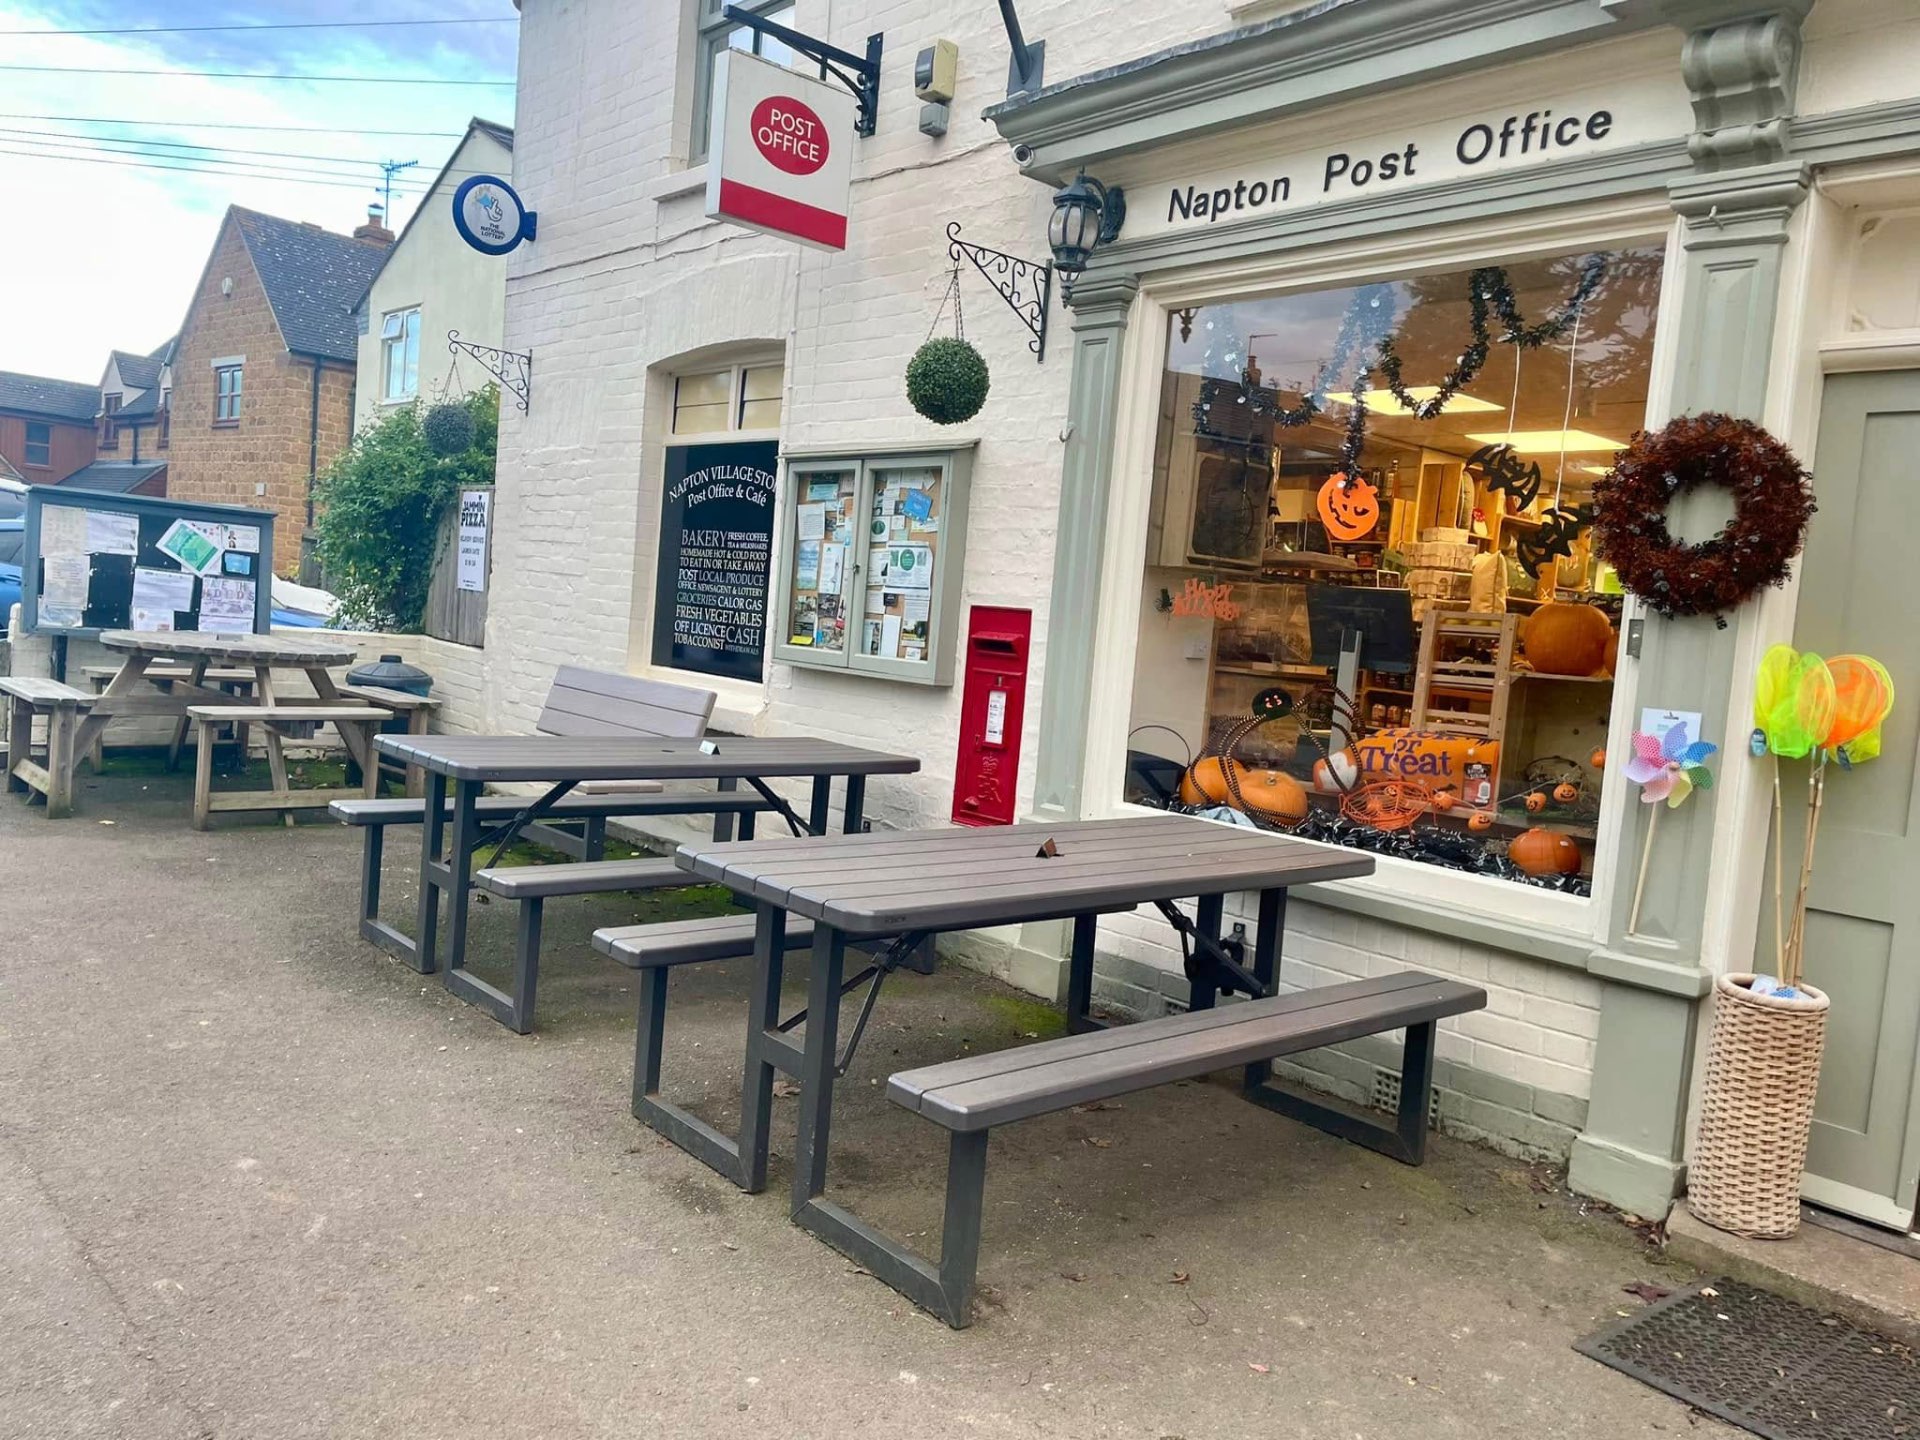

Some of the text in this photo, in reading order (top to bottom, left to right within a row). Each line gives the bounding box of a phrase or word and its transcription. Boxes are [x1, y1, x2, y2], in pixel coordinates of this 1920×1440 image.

[770, 108, 815, 139] POST
[758, 126, 820, 163] OFFICE
[1167, 110, 1613, 222] Napton Post Office
[480, 225, 506, 237] NATIONAL
[481, 230, 504, 240] LOTTERY
[669, 468, 709, 503] NAPTON
[711, 465, 754, 482] VILLAGE
[688, 483, 767, 508] Post Office & Café
[461, 513, 486, 527] PIZZA
[682, 529, 727, 547] BAKERY
[727, 531, 745, 541] FRESH
[740, 542, 767, 550] MILKSHAKES
[680, 547, 767, 561] HOMEMADE HOT & COLD FOOD
[680, 557, 766, 572] TO EAT IN OR TAKE AWAY
[678, 568, 765, 587] POST LOCAL PRODUCE
[677, 580, 764, 597] OFFICE NEWSAGENT & LOTTERY
[676, 591, 763, 611] GROCERIES CALOR GAS
[675, 604, 762, 627] FRESH VEGETABLES
[674, 619, 760, 646] OFF LICENCE CASH
[674, 633, 725, 650] TOBACCONIST
[1393, 738, 1422, 754] or
[1359, 746, 1453, 776] Treat
